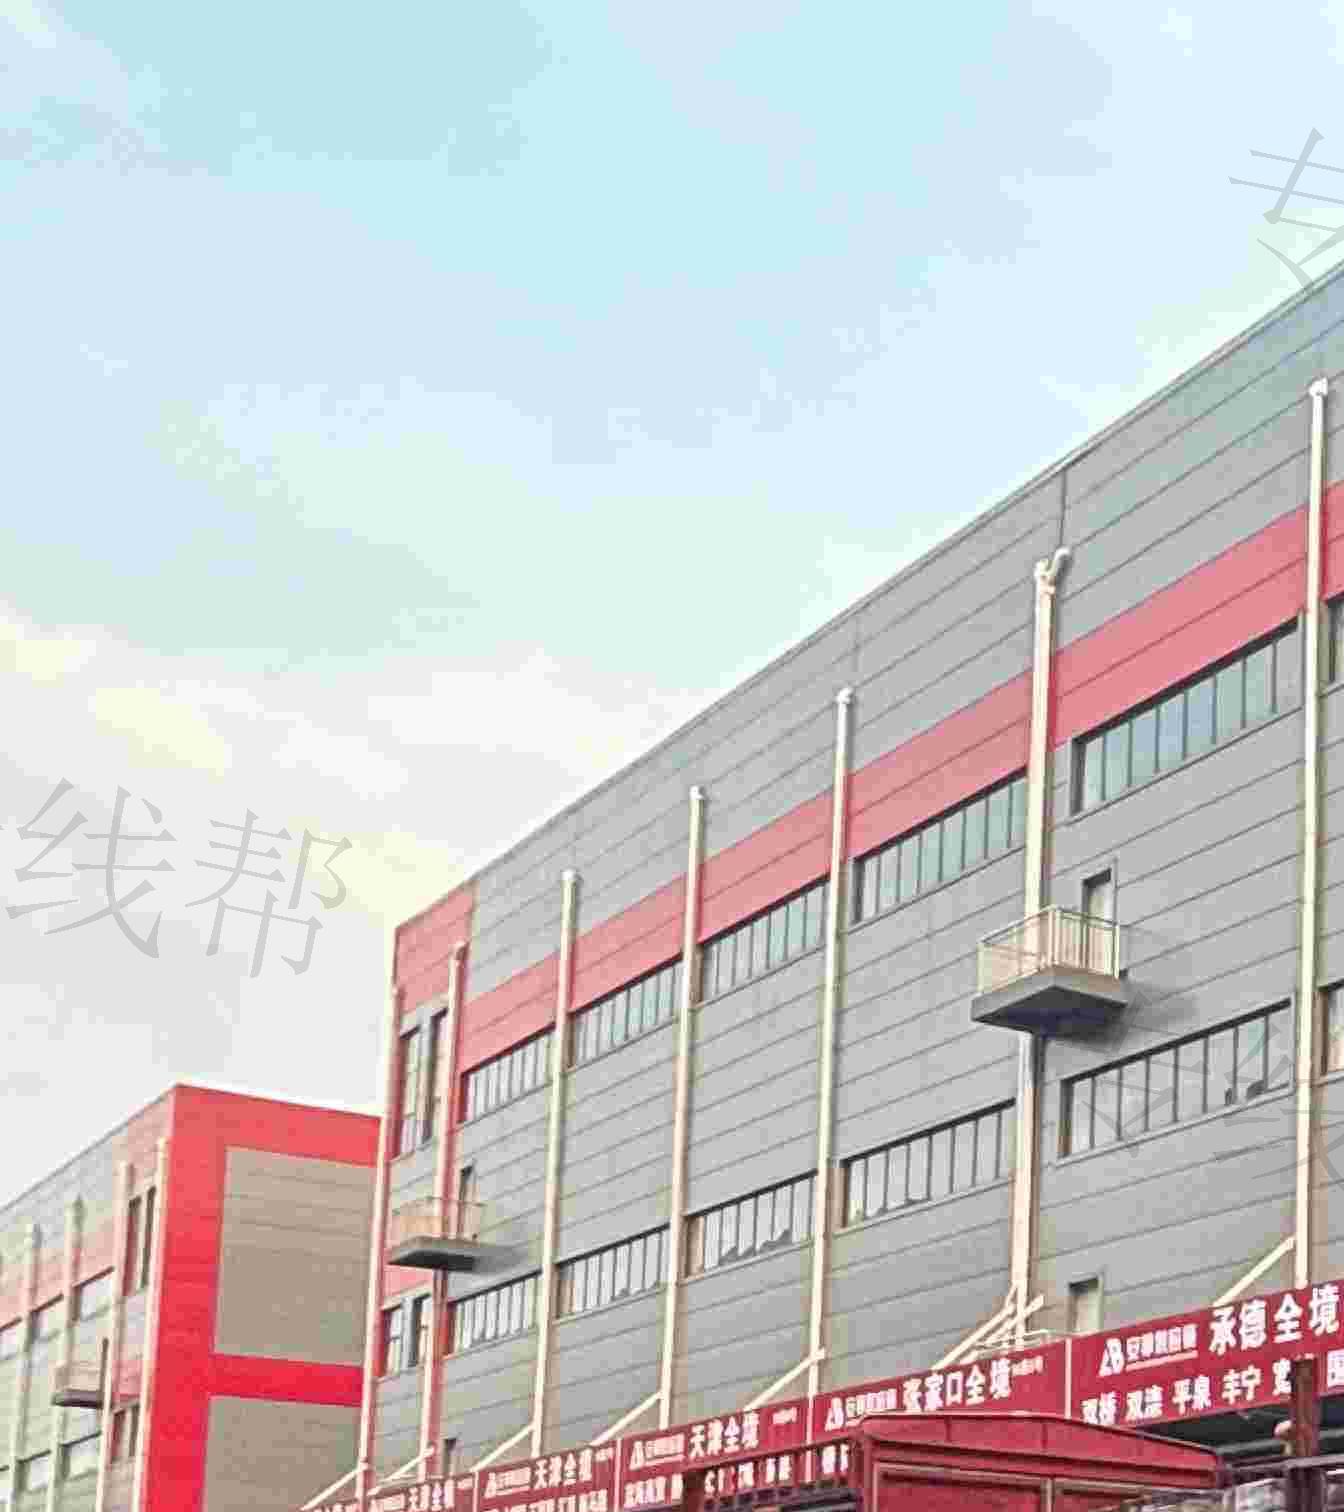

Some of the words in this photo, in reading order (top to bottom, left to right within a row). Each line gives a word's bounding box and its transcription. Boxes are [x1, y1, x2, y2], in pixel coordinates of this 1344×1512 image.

[1208, 1285, 1341, 1356] 承德全境
[902, 1357, 1012, 1413] 张家口全境
[689, 1411, 760, 1460] 天津全境
